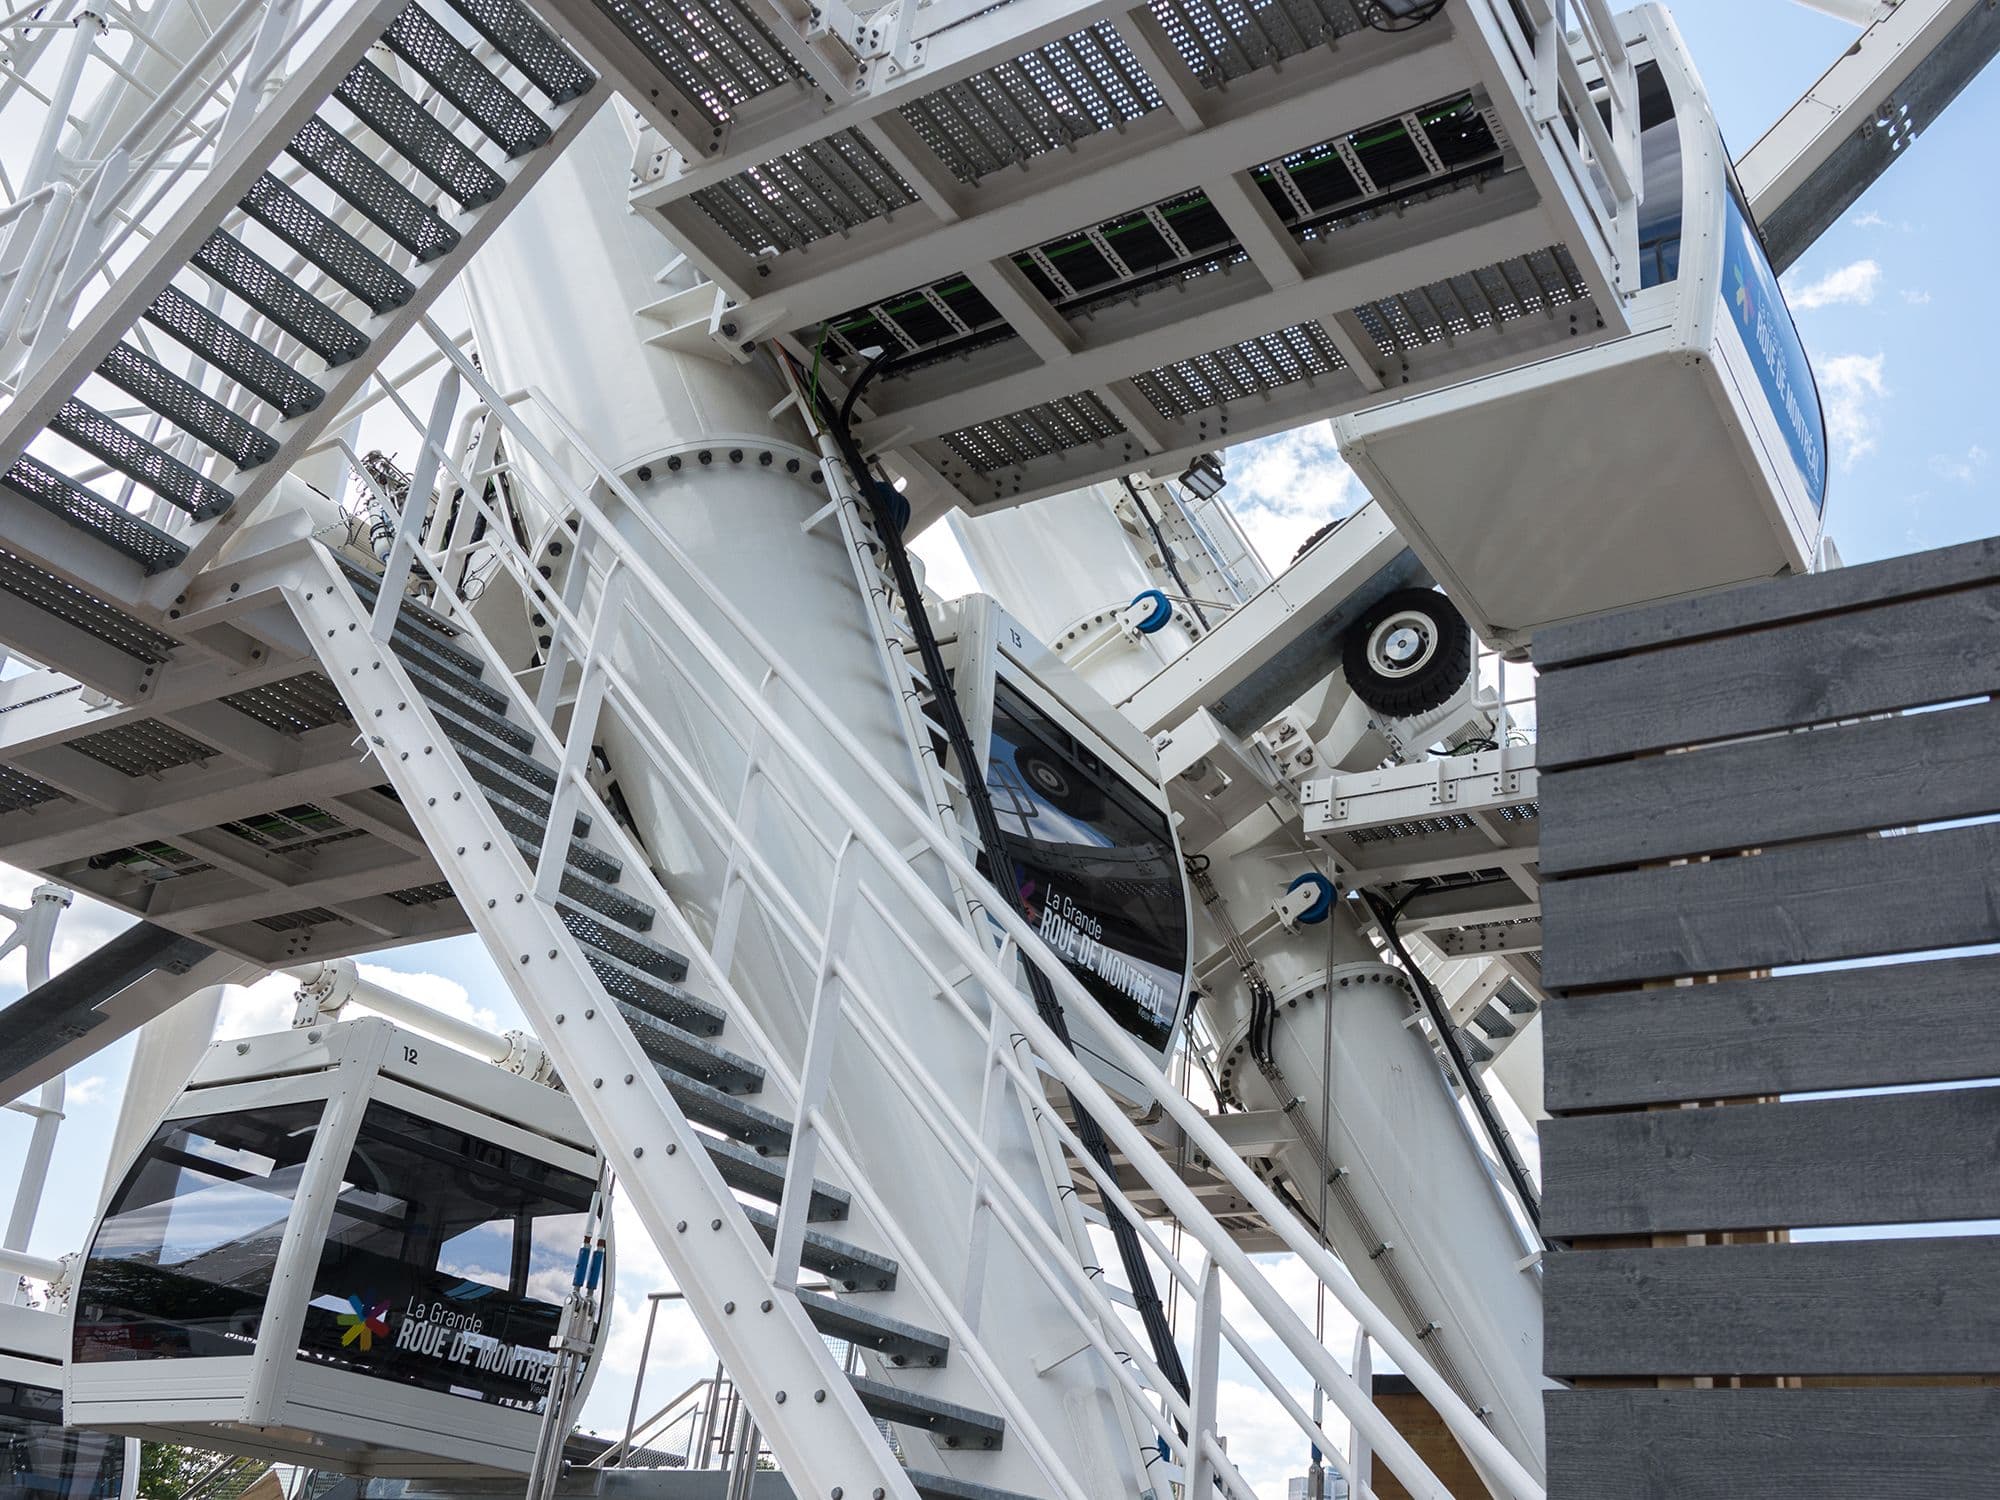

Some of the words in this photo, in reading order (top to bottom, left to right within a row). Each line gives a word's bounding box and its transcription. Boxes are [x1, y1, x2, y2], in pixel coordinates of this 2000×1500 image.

[1756, 311, 1777, 377] ROUE
[1009, 627, 1022, 649] 13
[1045, 883, 1061, 911] La
[1062, 896, 1102, 941] Grande
[1039, 906, 1080, 957] ROUE
[1077, 933, 1100, 972] DE
[1097, 946, 1165, 1018] MONTRÉAL
[403, 1045, 418, 1066] 12
[406, 1295, 427, 1319] La
[429, 1302, 483, 1334] Grande
[396, 1318, 451, 1358] ROUE
[448, 1331, 478, 1366] DE
[475, 1338, 566, 1391] MONTRÉA
